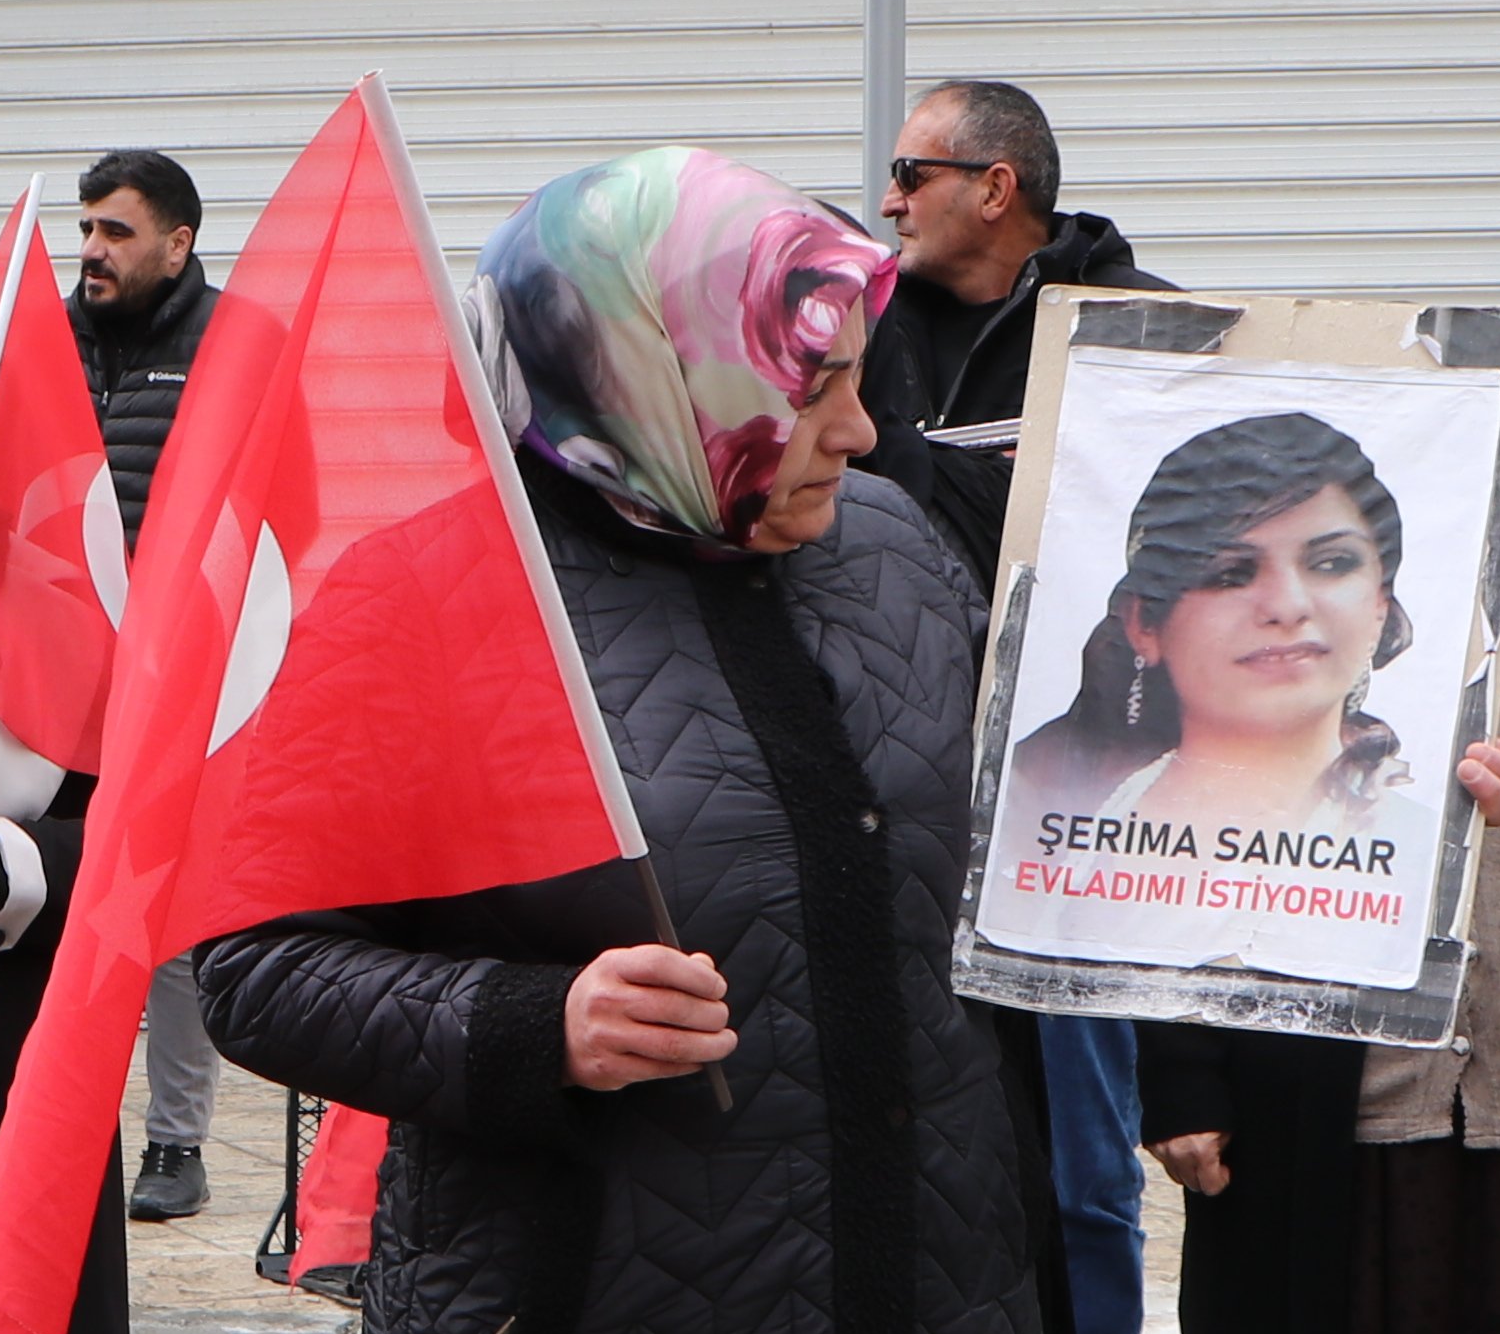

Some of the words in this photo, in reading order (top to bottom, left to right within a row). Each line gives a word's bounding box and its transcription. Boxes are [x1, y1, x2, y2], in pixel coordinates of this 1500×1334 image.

[1037, 811, 1199, 859] ŞERİMA
[1213, 827, 1396, 876] SANCAR
[1014, 860, 1185, 906] EVLADIMI
[1196, 870, 1403, 926] İSTİYORUM!
